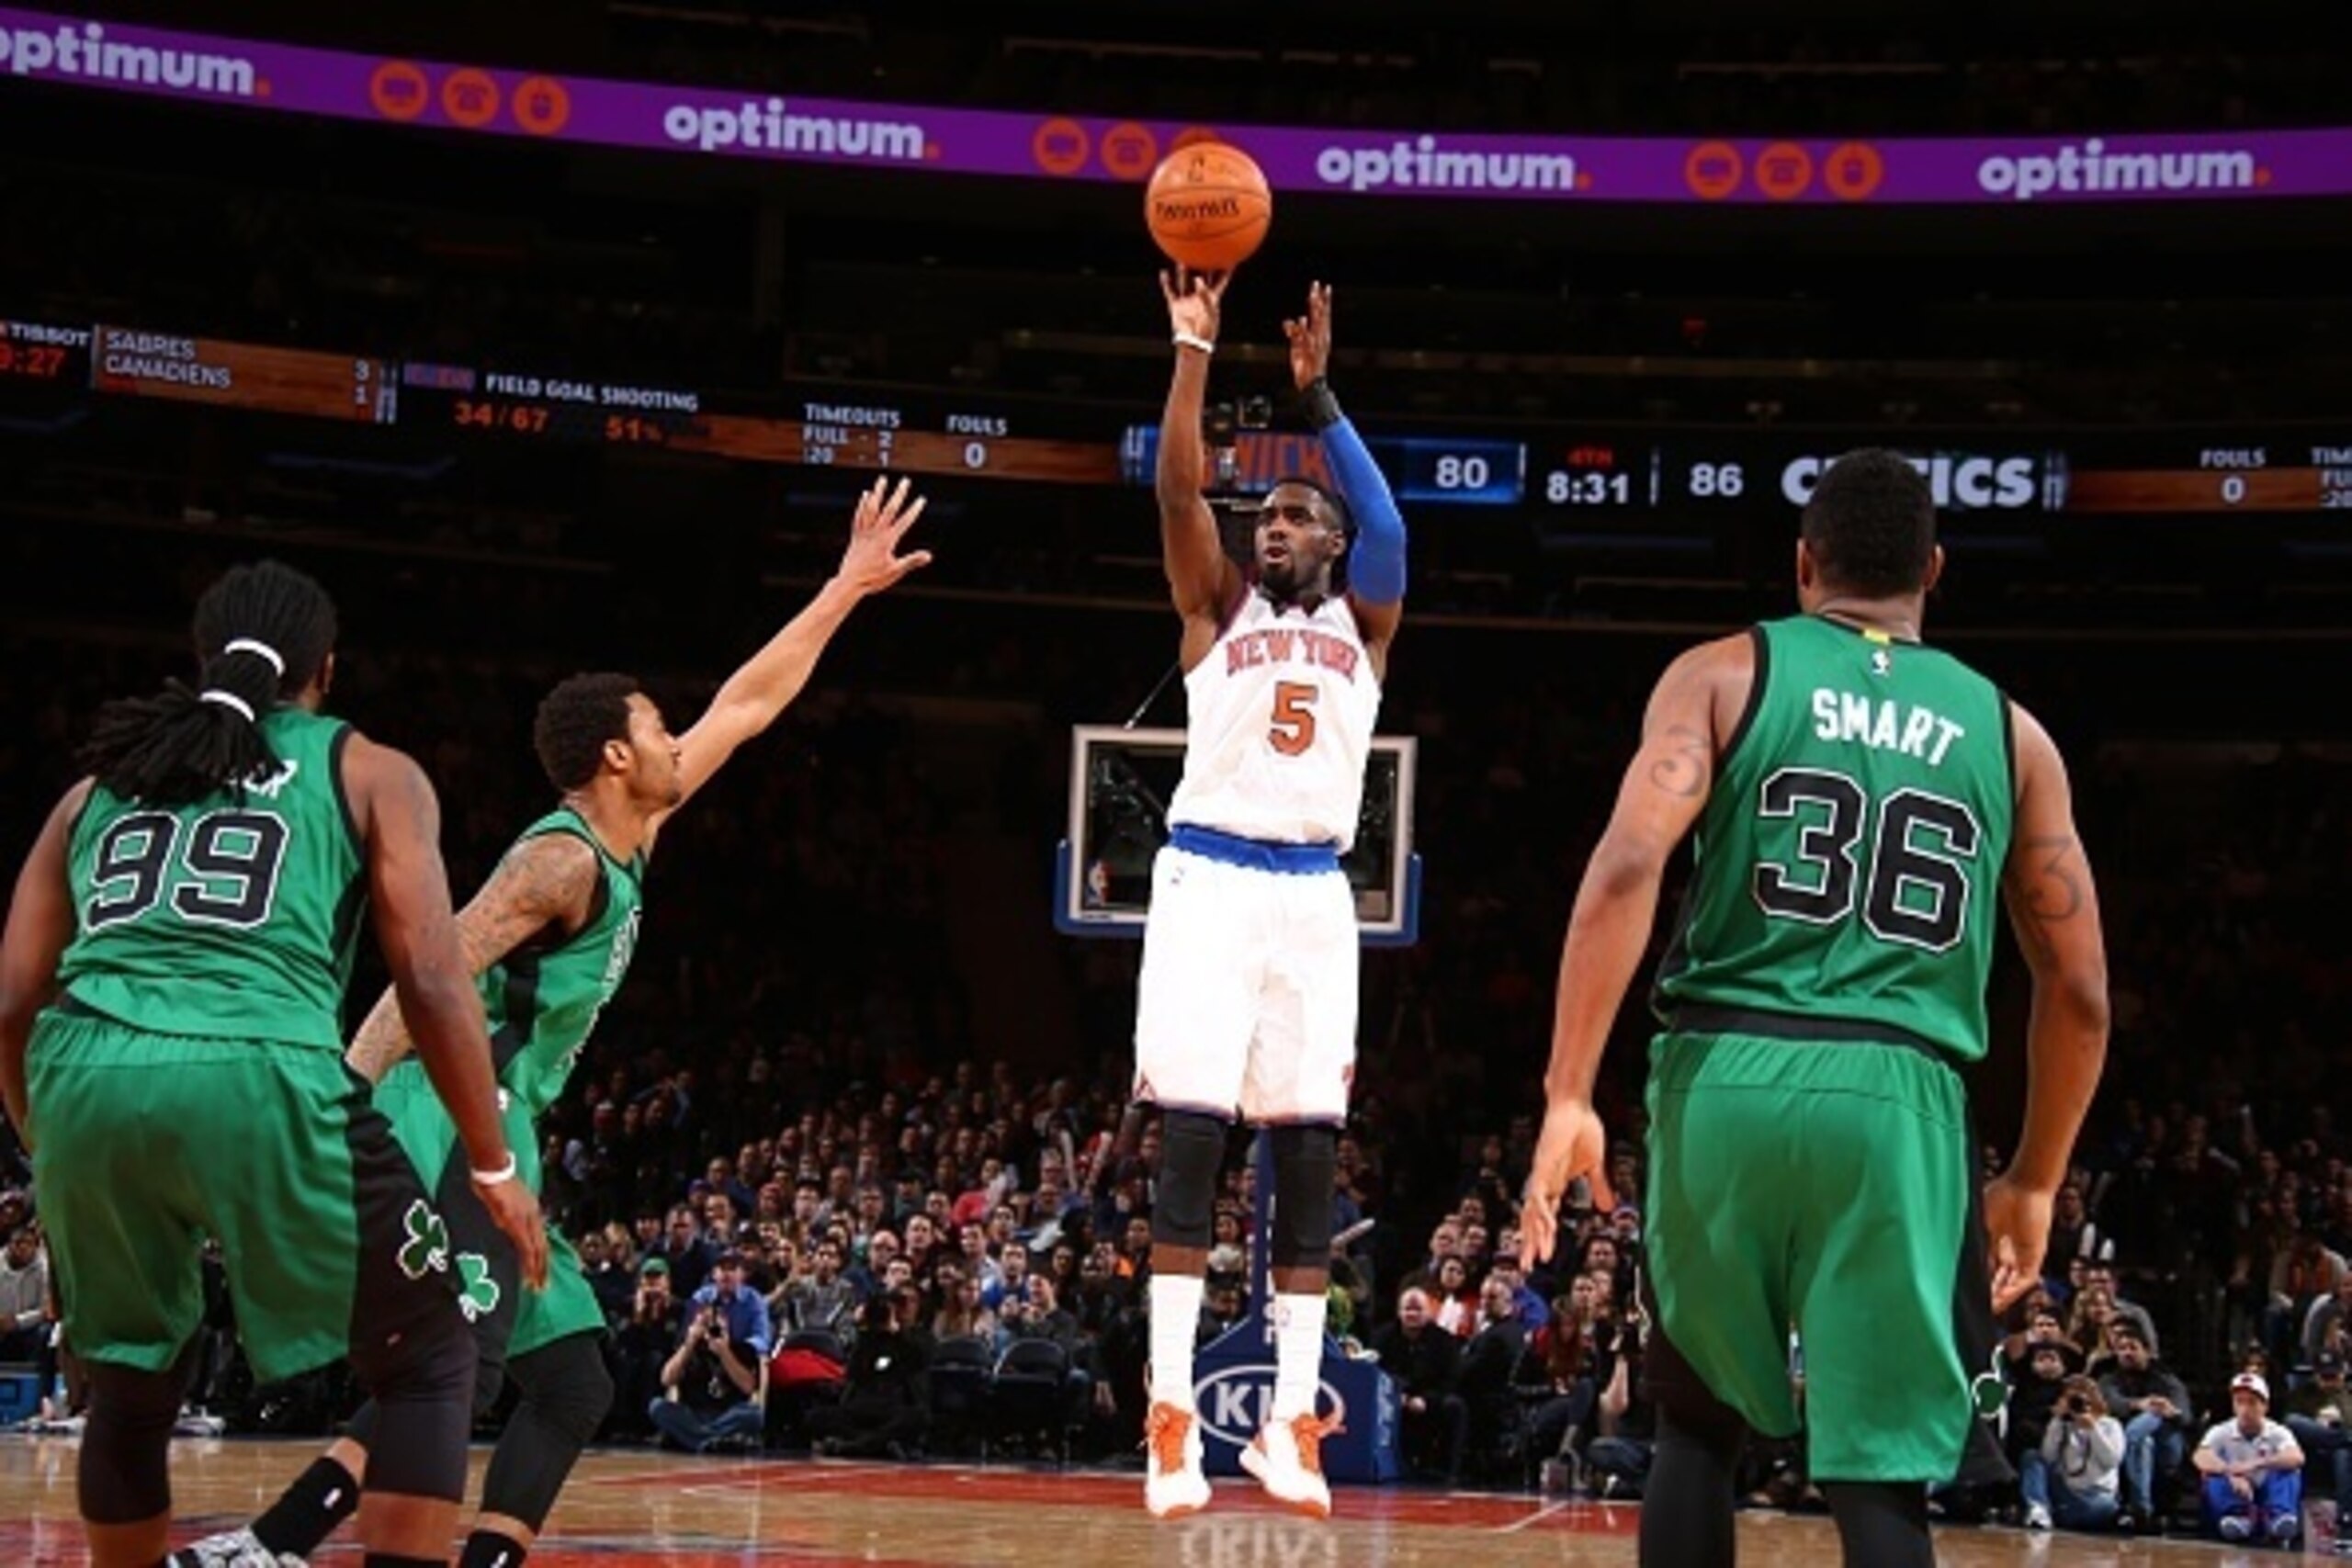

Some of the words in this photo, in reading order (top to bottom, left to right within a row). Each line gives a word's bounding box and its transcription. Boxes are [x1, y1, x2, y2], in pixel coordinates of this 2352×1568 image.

[106, 331, 195, 359] SABRES
[106, 355, 232, 389] CANADIENS
[486, 373, 541, 396] FIELD
[546, 379, 594, 402] GOAL
[601, 386, 698, 412] SHOOTING
[805, 402, 899, 428] TIMEOUTS
[947, 413, 1007, 436] FOULS
[803, 423, 848, 446] FULL
[964, 442, 985, 468] 0
[2200, 446, 2266, 468] FOULS
[1435, 457, 1489, 489] 80
[1546, 471, 1630, 504] 8:31
[1689, 462, 1743, 496] 86
[1781, 457, 2034, 506] CICS
[2222, 475, 2245, 504] 0
[1226, 628, 1292, 677] NEW
[1268, 681, 1319, 757] 5
[1812, 688, 1964, 766] SMART
[86, 807, 290, 932] 99
[1753, 767, 1981, 954] 36
[1215, 1381, 1276, 1426] KI
